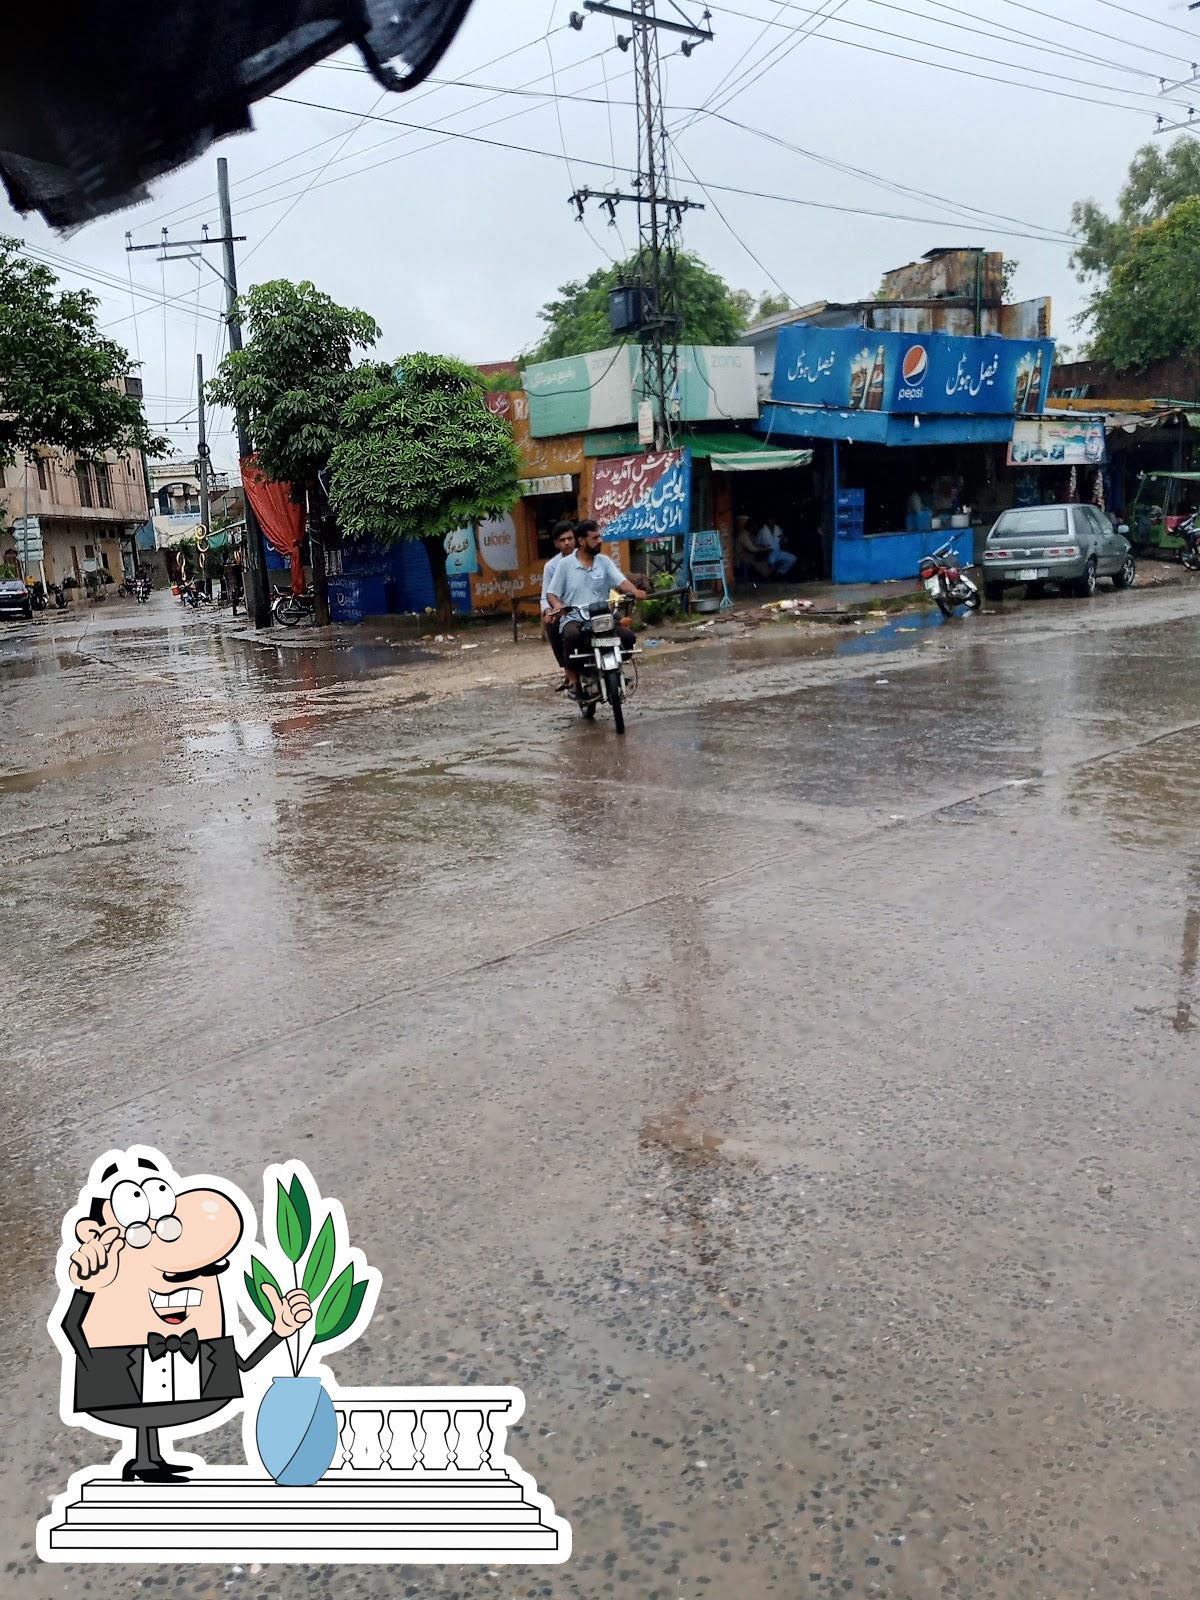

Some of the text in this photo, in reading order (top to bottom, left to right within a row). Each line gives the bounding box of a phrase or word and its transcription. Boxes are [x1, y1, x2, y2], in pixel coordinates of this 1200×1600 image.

[788, 349, 835, 383] فیصل ہوٹل
[945, 352, 999, 396] فیصل ہوٹل
[898, 387, 924, 401] pepsi
[610, 458, 636, 485] آمدید
[632, 452, 674, 482] خوش
[613, 482, 636, 509] گرین
[632, 477, 652, 511] چوکی
[651, 469, 685, 508] پولیس
